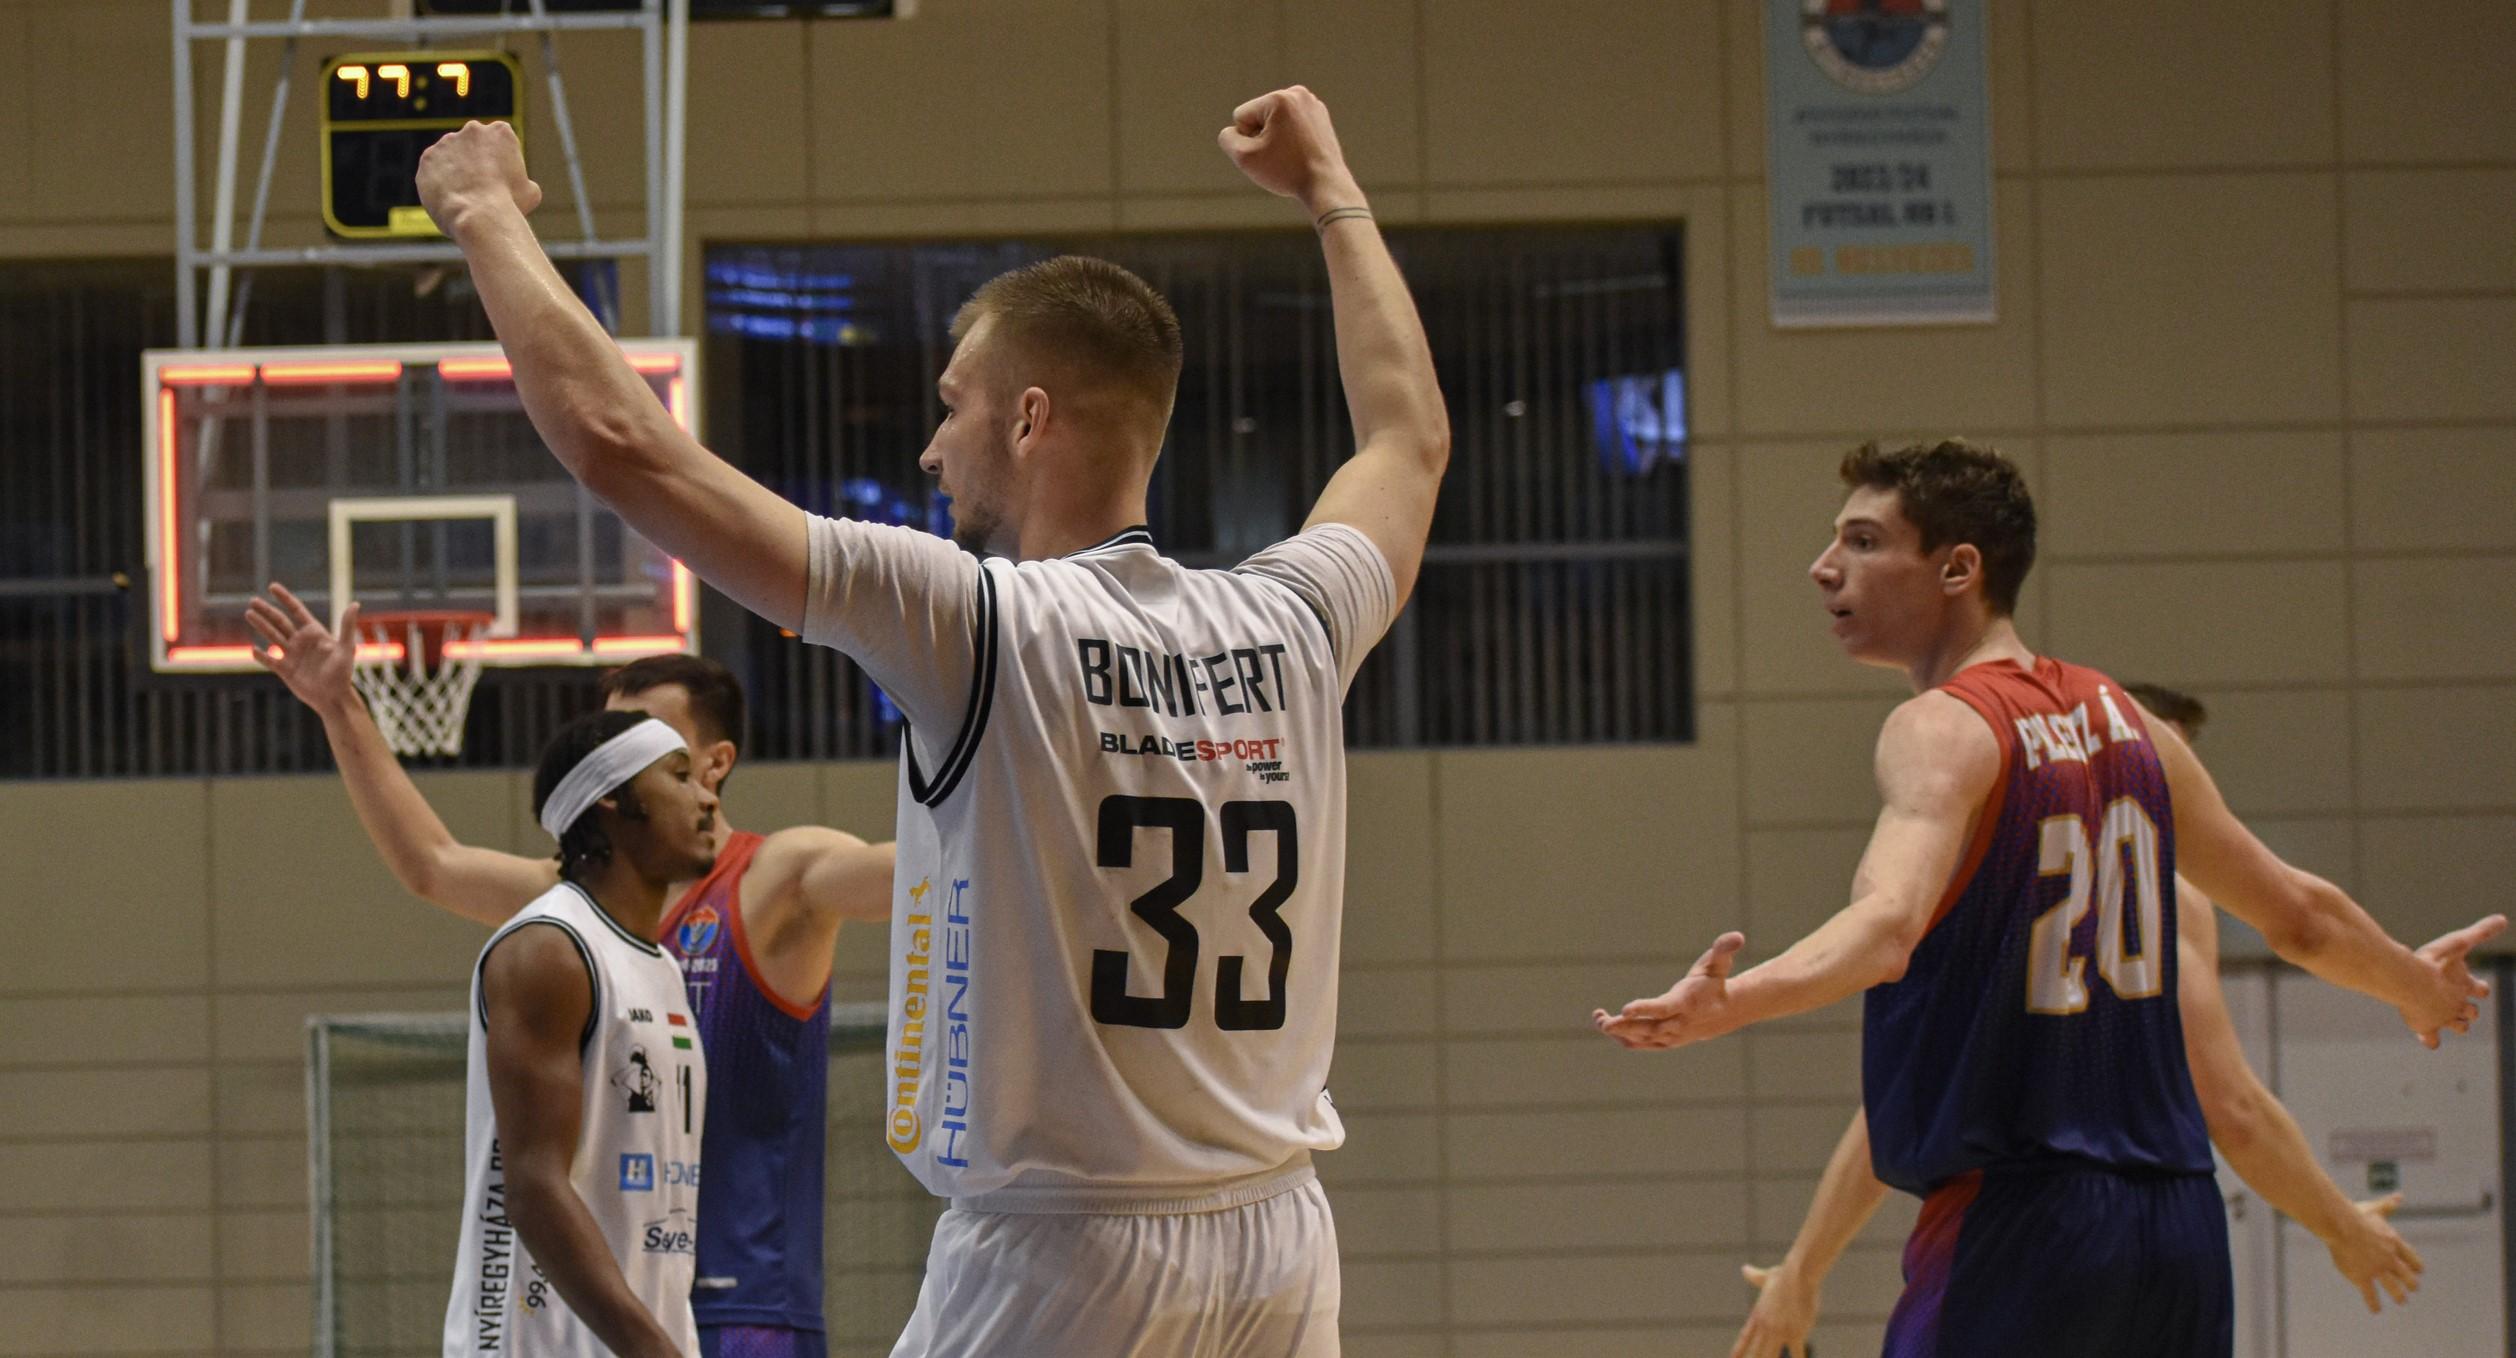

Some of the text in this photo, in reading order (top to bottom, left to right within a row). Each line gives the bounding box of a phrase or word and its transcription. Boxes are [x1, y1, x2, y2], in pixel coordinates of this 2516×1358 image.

[1078, 639, 1286, 718] BONIFERT
[1100, 731, 1280, 761] BLADESPORT
[1252, 761, 1282, 774] power
[1091, 794, 1299, 1031] 33
[2026, 795, 2163, 1015] 20
[887, 913, 933, 1155] Continental
[936, 878, 971, 1168] HÜBNER
[474, 1183, 514, 1351] NYÍREGYHÁZA
